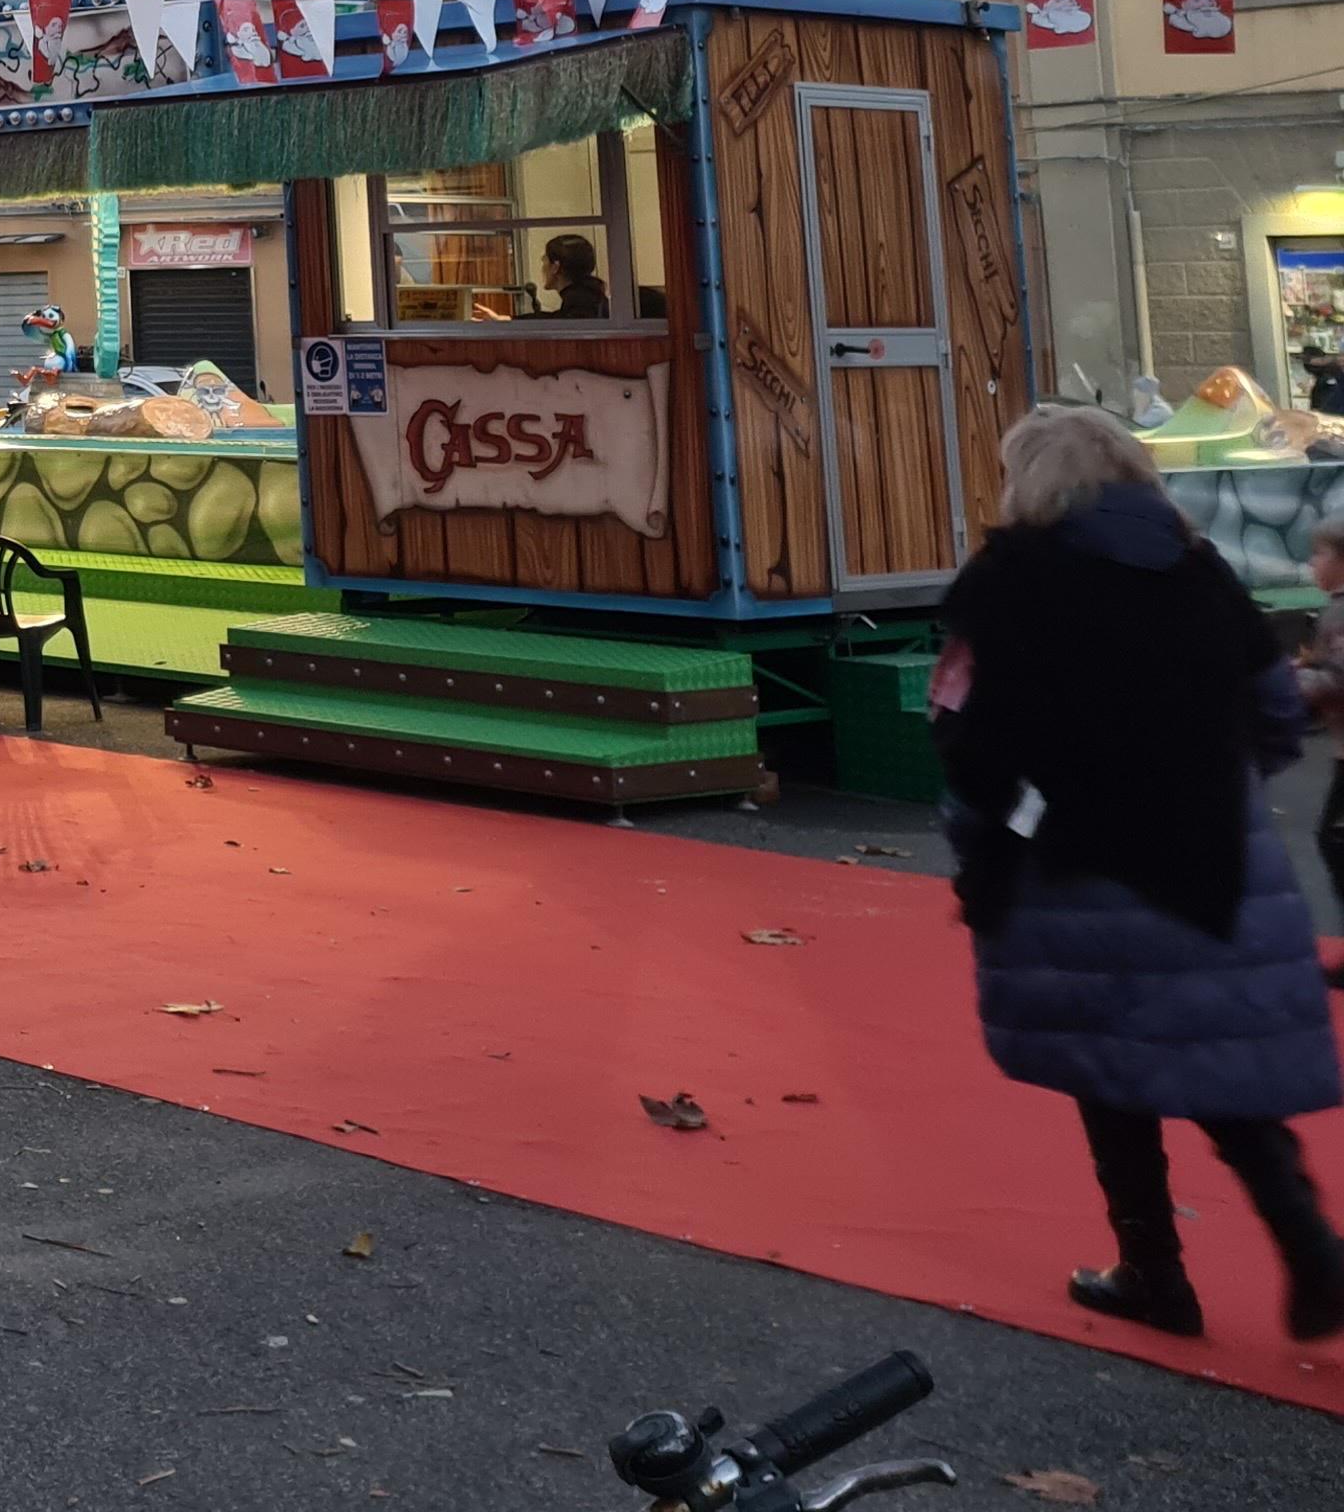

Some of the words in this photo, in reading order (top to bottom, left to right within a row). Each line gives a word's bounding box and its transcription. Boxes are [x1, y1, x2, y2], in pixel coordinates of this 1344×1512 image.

[146, 254, 234, 264] ARTWORK
[962, 183, 1000, 284] SECCHI
[740, 340, 797, 414] SECCHI
[405, 398, 595, 494] CASSA
